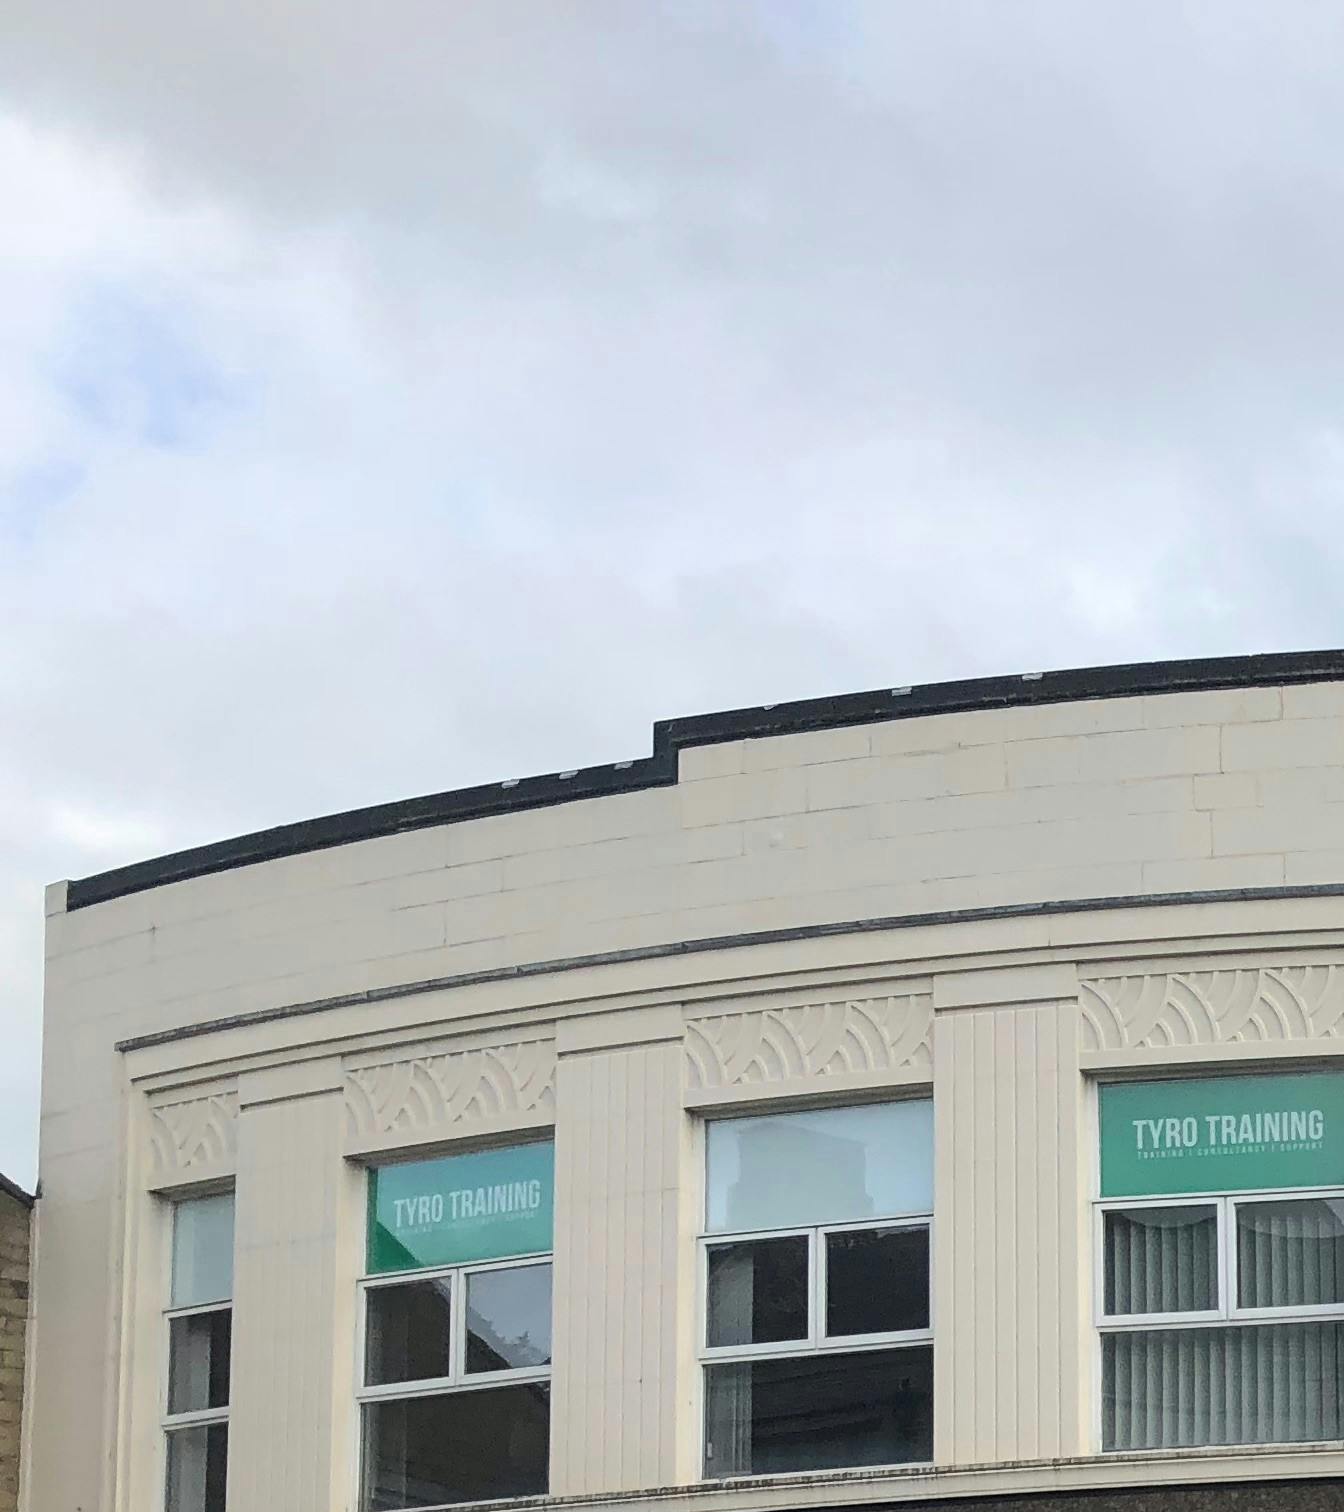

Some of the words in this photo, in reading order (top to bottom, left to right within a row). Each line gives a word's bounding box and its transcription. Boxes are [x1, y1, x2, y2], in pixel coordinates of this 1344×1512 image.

[1132, 1117, 1198, 1149] TYRO
[1205, 1109, 1324, 1146] TRAINING
[393, 1194, 444, 1228] TYRO
[449, 1179, 541, 1220] TRAINING
